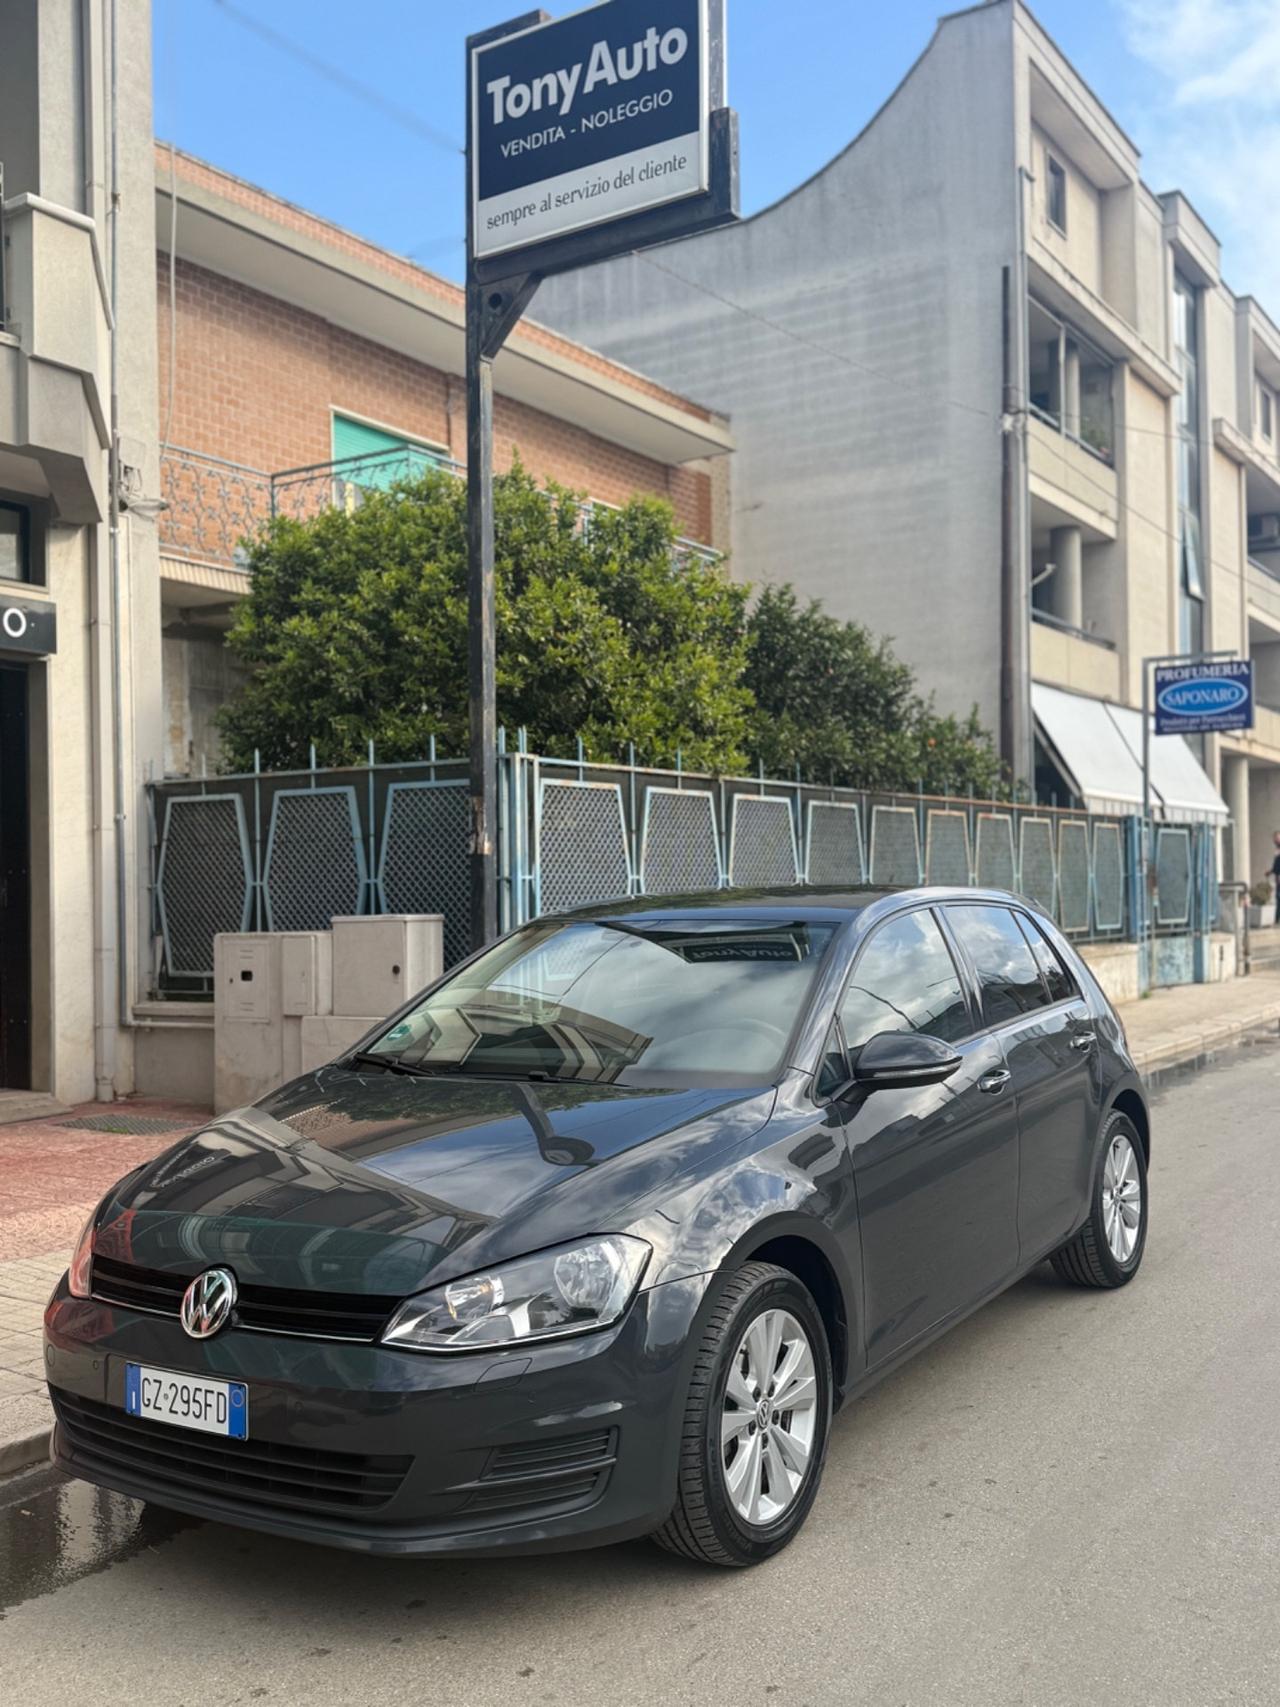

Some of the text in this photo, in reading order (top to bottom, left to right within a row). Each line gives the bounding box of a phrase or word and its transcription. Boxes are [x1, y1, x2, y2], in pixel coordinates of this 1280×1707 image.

[501, 126, 566, 158] VENDITA
[581, 89, 673, 133] NOLEGGIO
[487, 154, 687, 230] sempre al servizio del cliente
[1157, 664, 1248, 681] PROFUMERIA
